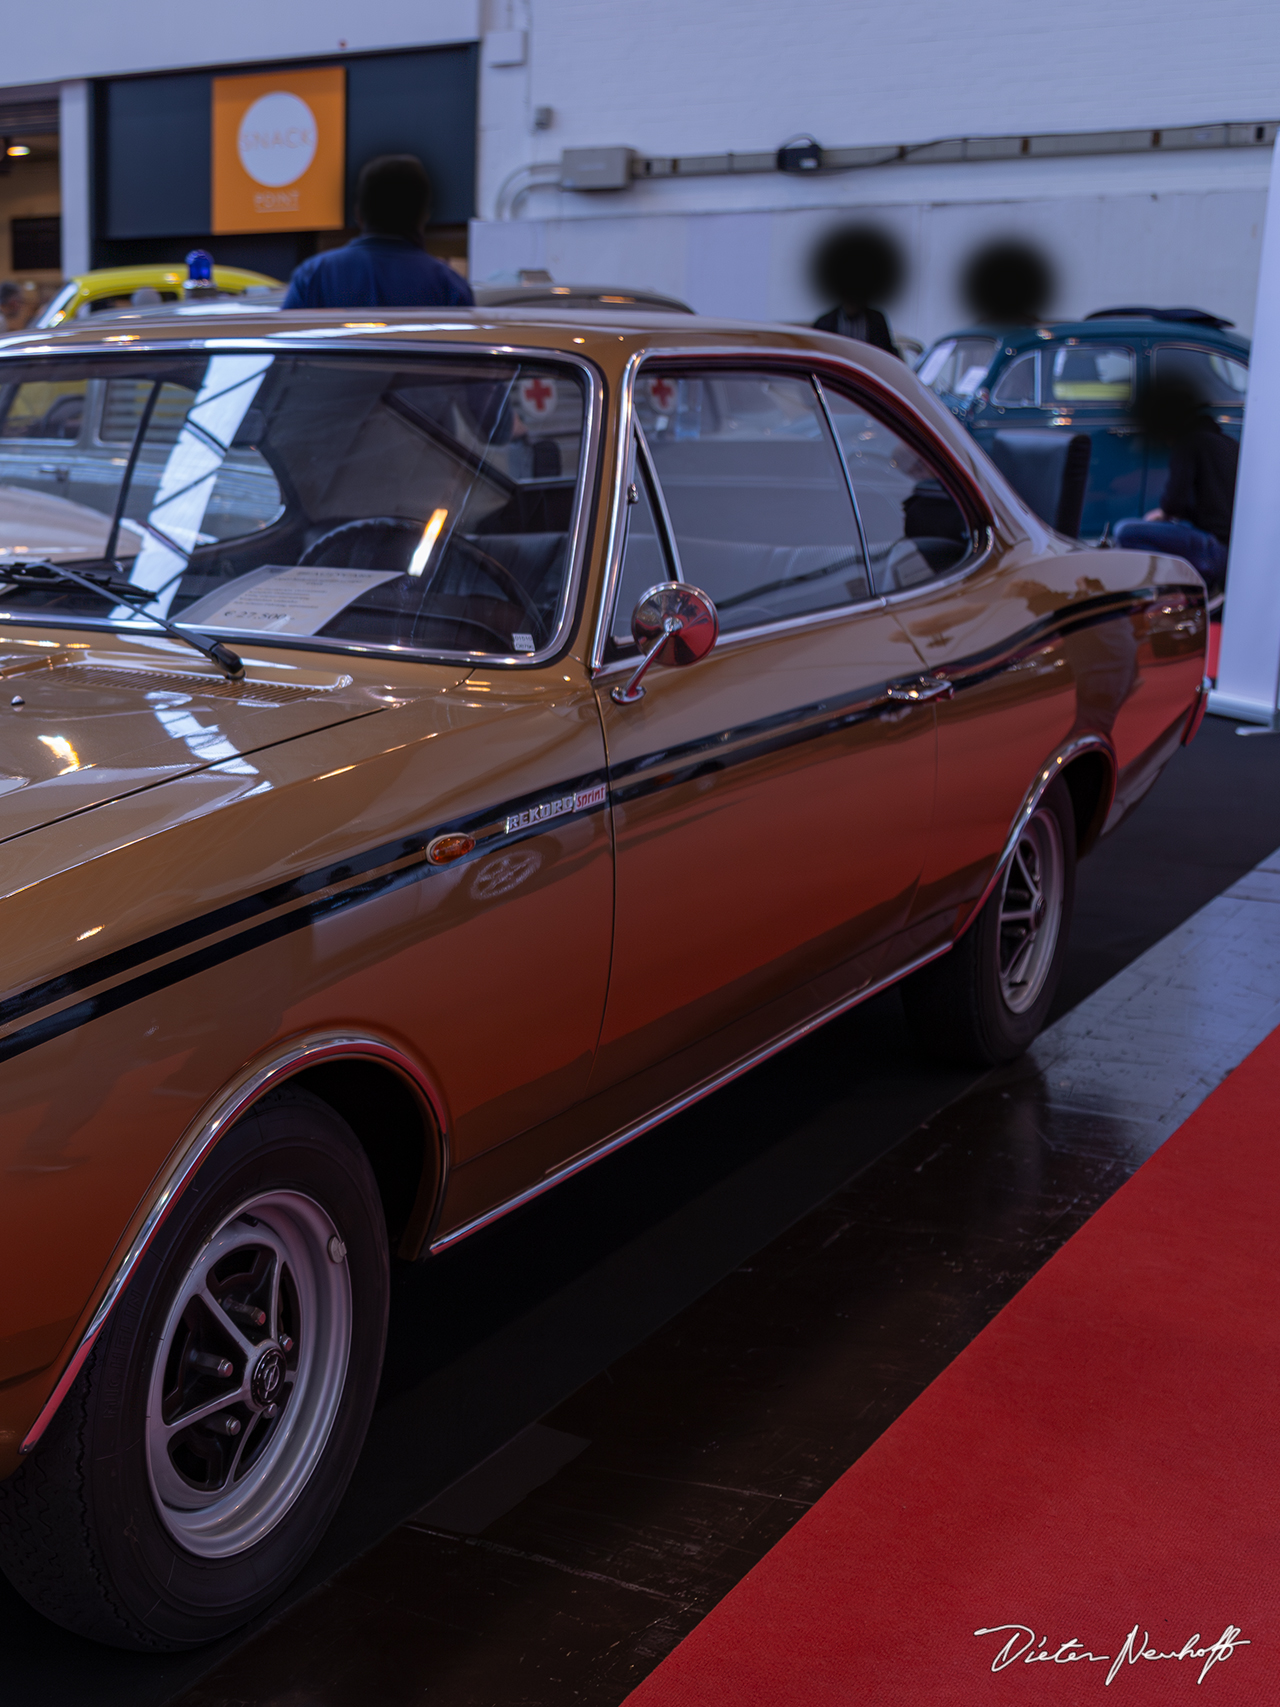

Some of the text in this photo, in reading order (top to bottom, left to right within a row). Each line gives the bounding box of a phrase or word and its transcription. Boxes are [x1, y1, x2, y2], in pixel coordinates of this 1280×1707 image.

[241, 128, 314, 152] SNACK
[255, 191, 299, 208] POINT
[509, 787, 605, 829] REKORD sprint
[103, 1287, 142, 1419] MICHELIN
